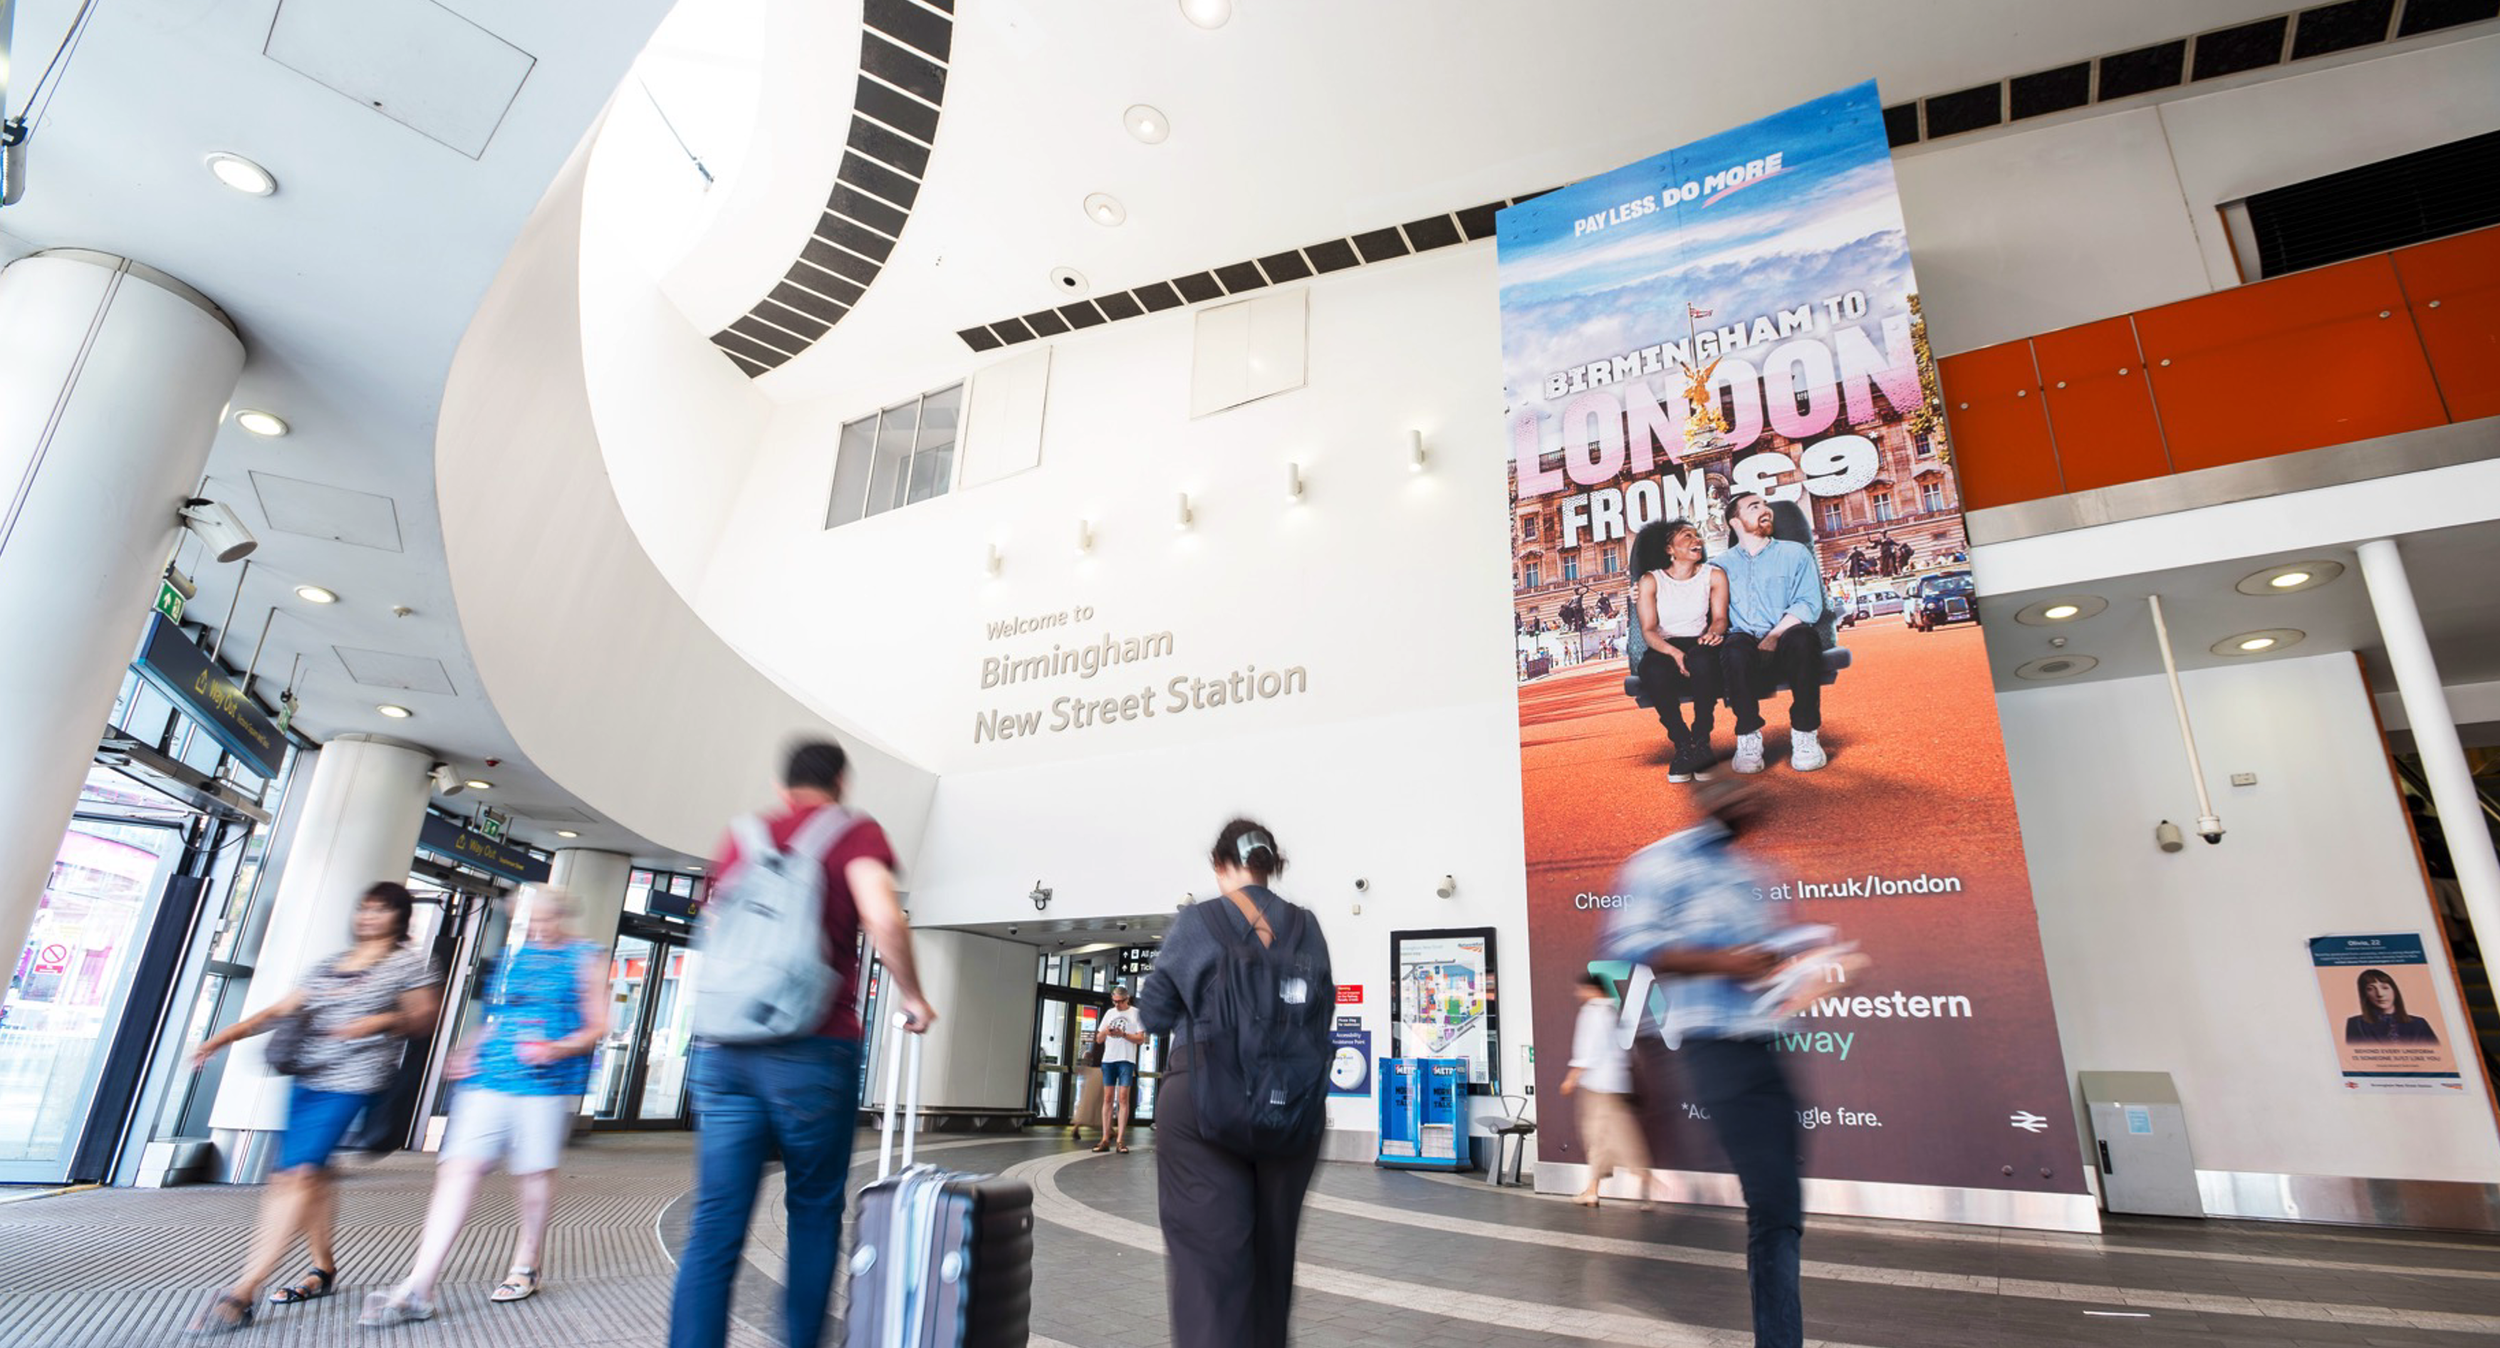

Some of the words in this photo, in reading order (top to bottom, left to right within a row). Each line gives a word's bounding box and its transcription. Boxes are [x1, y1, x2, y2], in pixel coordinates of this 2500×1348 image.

[1574, 211, 1607, 237] PAY
[1609, 195, 1660, 226] LESS.
[1662, 181, 1700, 208] DO
[1703, 151, 1783, 195] MORE
[1545, 304, 1814, 400] BIRMINGHAM
[1824, 290, 1867, 325] TO
[1514, 313, 1924, 499] LONDON
[1562, 467, 1709, 548] FROM
[986, 611, 1068, 641] Welcome
[1073, 604, 1094, 622] to
[980, 630, 1174, 690] Birmingham
[209, 679, 226, 710] Way
[224, 694, 238, 718] Out
[974, 709, 1042, 744] New
[1049, 685, 1156, 732] Street
[1166, 664, 1307, 714] Station
[469, 839, 483, 856] Way
[484, 845, 497, 860] Out
[1770, 884, 1792, 901] at
[1797, 874, 1961, 899] lnr.uk/london
[1837, 1107, 1883, 1127] fare.
